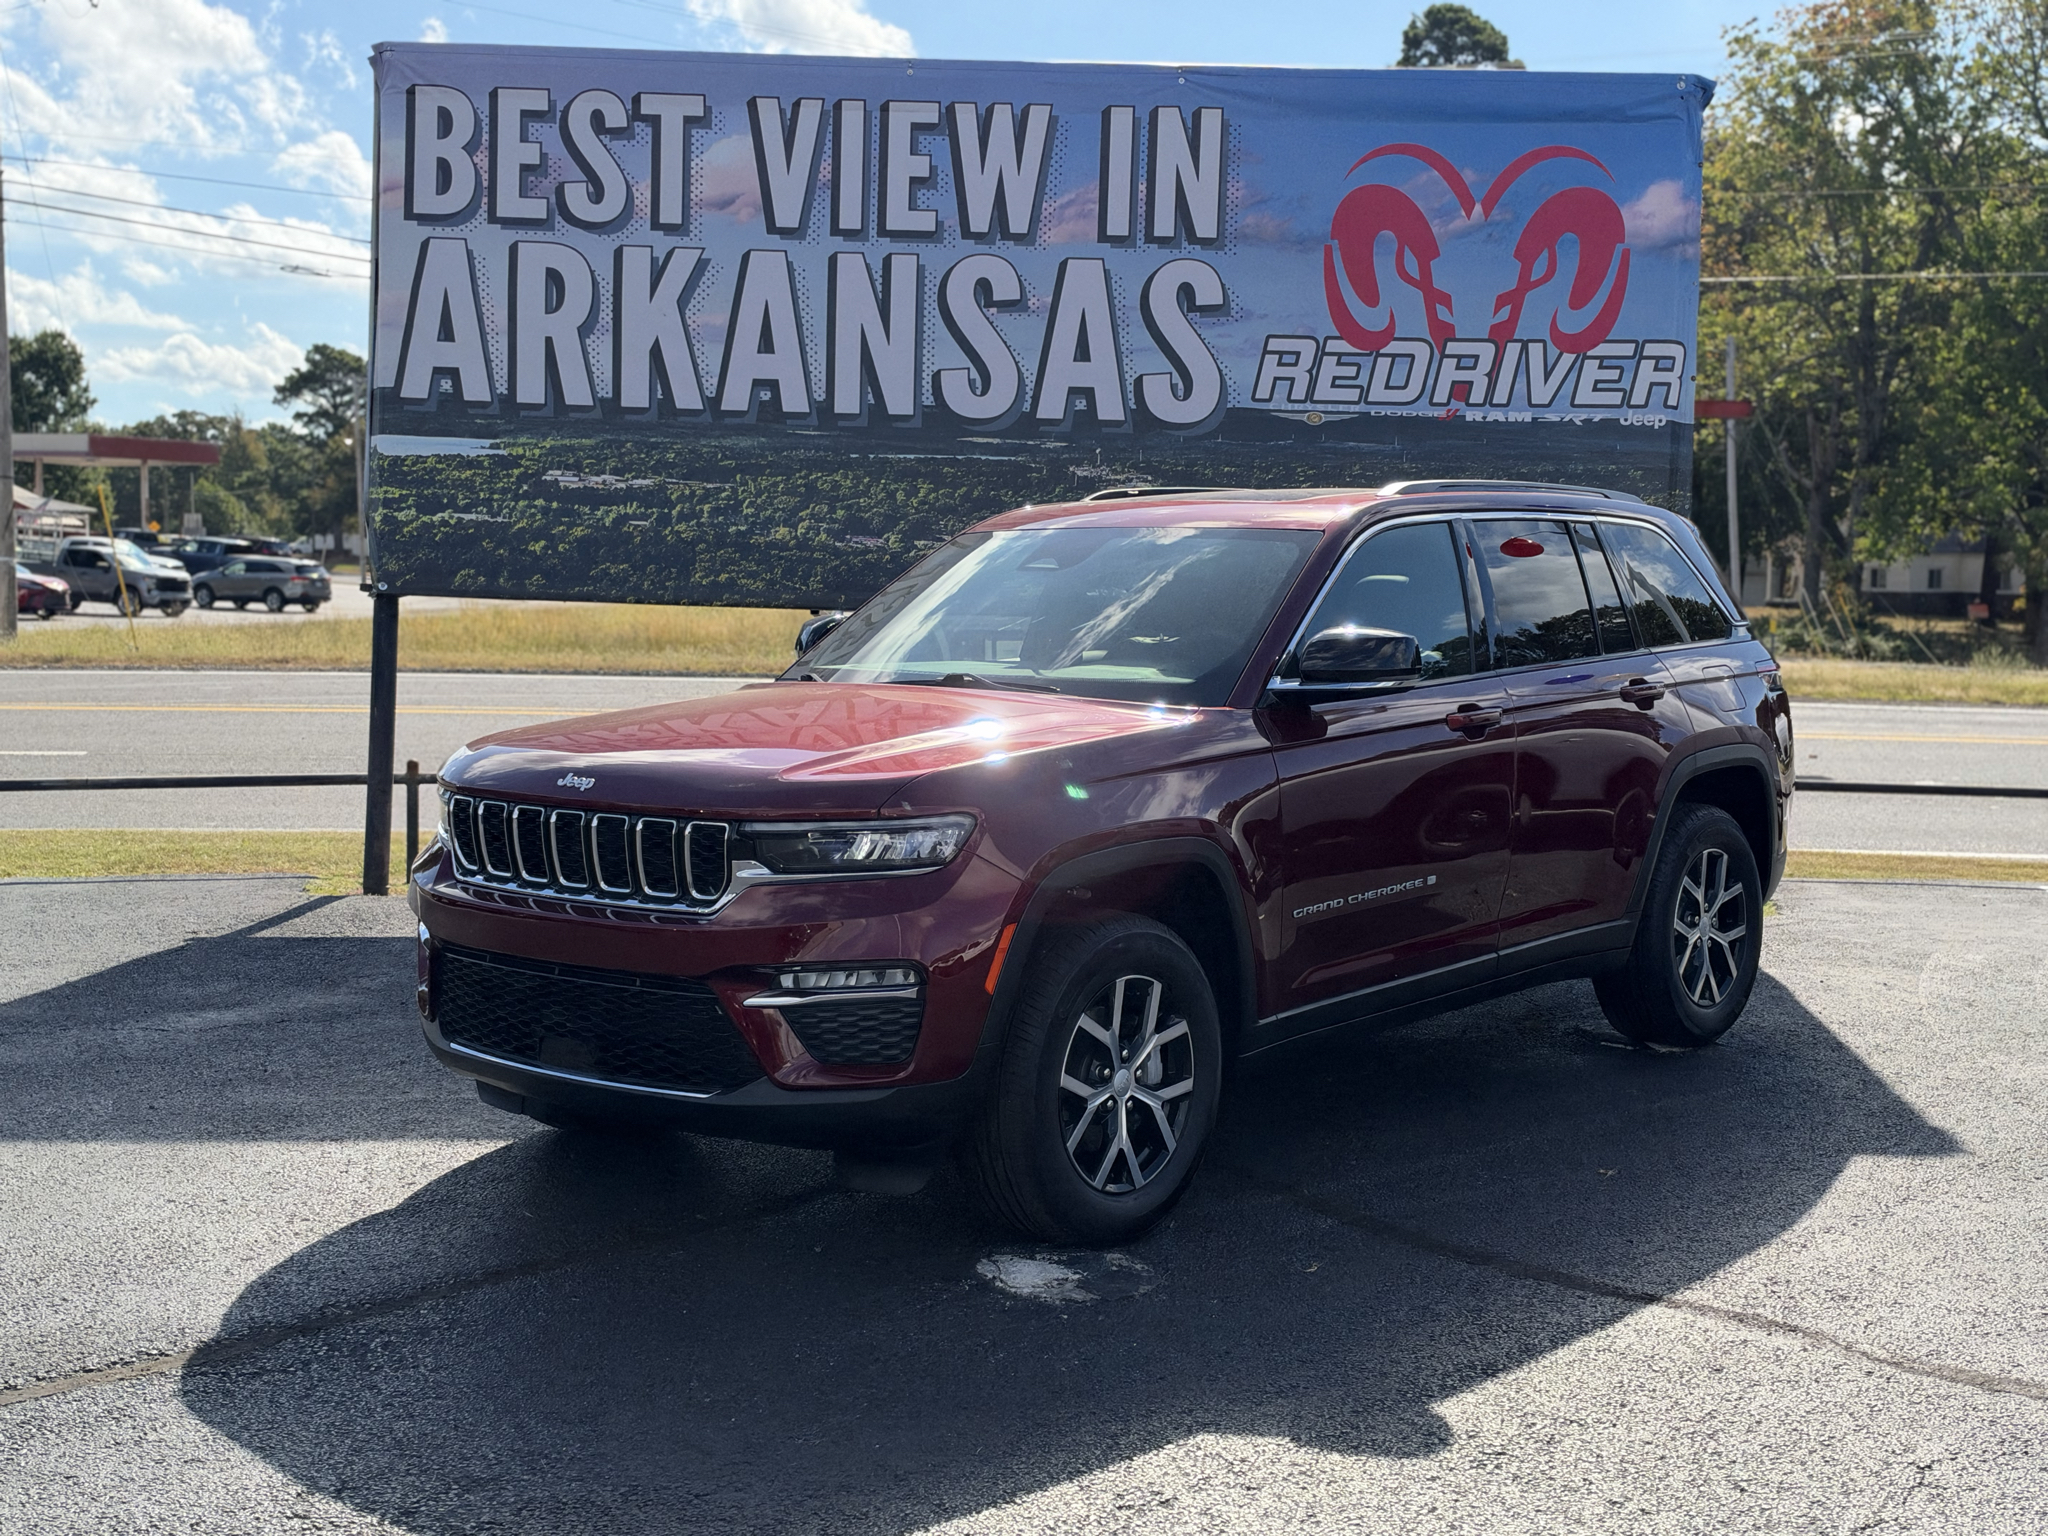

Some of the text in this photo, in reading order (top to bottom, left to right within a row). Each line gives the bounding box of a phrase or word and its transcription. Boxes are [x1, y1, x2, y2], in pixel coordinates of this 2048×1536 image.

[405, 85, 1226, 246] BEST VIEW IN
[395, 236, 1228, 428] ARKANSAS
[1370, 409, 1447, 418] DODGE
[1465, 411, 1532, 422] RAM
[1619, 410, 1667, 429] Jeep
[556, 772, 595, 791] Jeep
[1293, 878, 1424, 918] GRAND CHEROKEE
